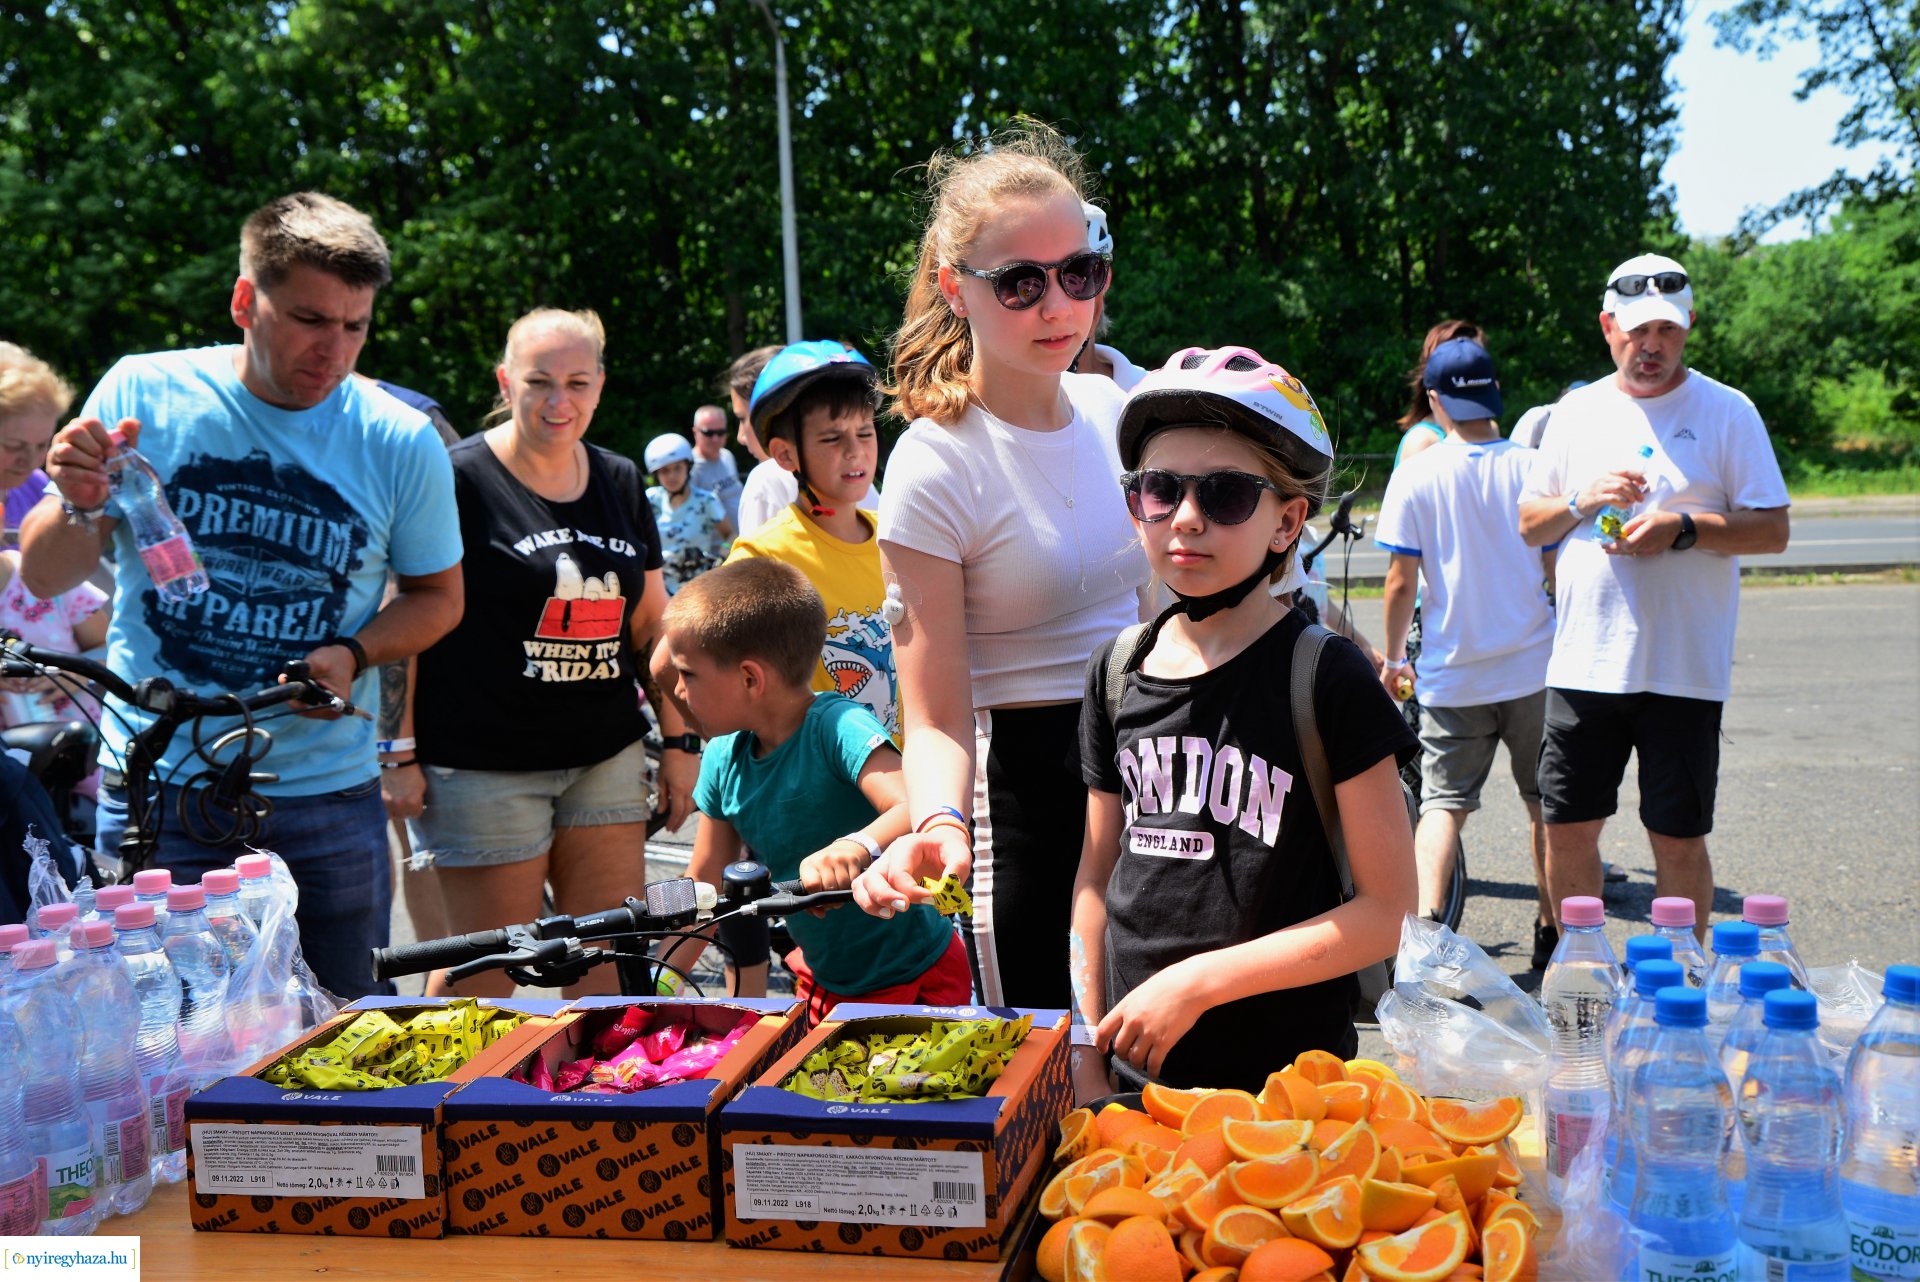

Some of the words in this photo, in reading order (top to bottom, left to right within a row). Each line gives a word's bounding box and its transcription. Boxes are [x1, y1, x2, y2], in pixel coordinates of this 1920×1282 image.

[176, 487, 352, 576] PREMIUM
[513, 527, 574, 556] WAKE
[609, 537, 637, 558] UP
[203, 556, 246, 575] WORK
[261, 565, 305, 586] WEAR
[523, 640, 593, 660] WHEN
[595, 641, 621, 660] IT'S
[522, 658, 621, 682] FRIDAY
[1136, 833, 1205, 853] ENGLAND
[459, 1123, 500, 1150] VALE
[517, 1127, 559, 1153] VALE
[558, 1139, 600, 1165] VALE
[617, 1143, 660, 1169] VALE
[56, 1158, 94, 1183] THEO
[212, 1174, 244, 1183] 09.11.2022
[250, 1175, 266, 1183] L918
[660, 1155, 702, 1181] VALE
[483, 1173, 525, 1199] VALE
[542, 1177, 584, 1204] VALE
[583, 1189, 626, 1216] VALE
[642, 1193, 685, 1220] VALE
[753, 1199, 789, 1207] 09.11.2022
[795, 1200, 812, 1208] L918
[467, 1212, 509, 1235] VALE
